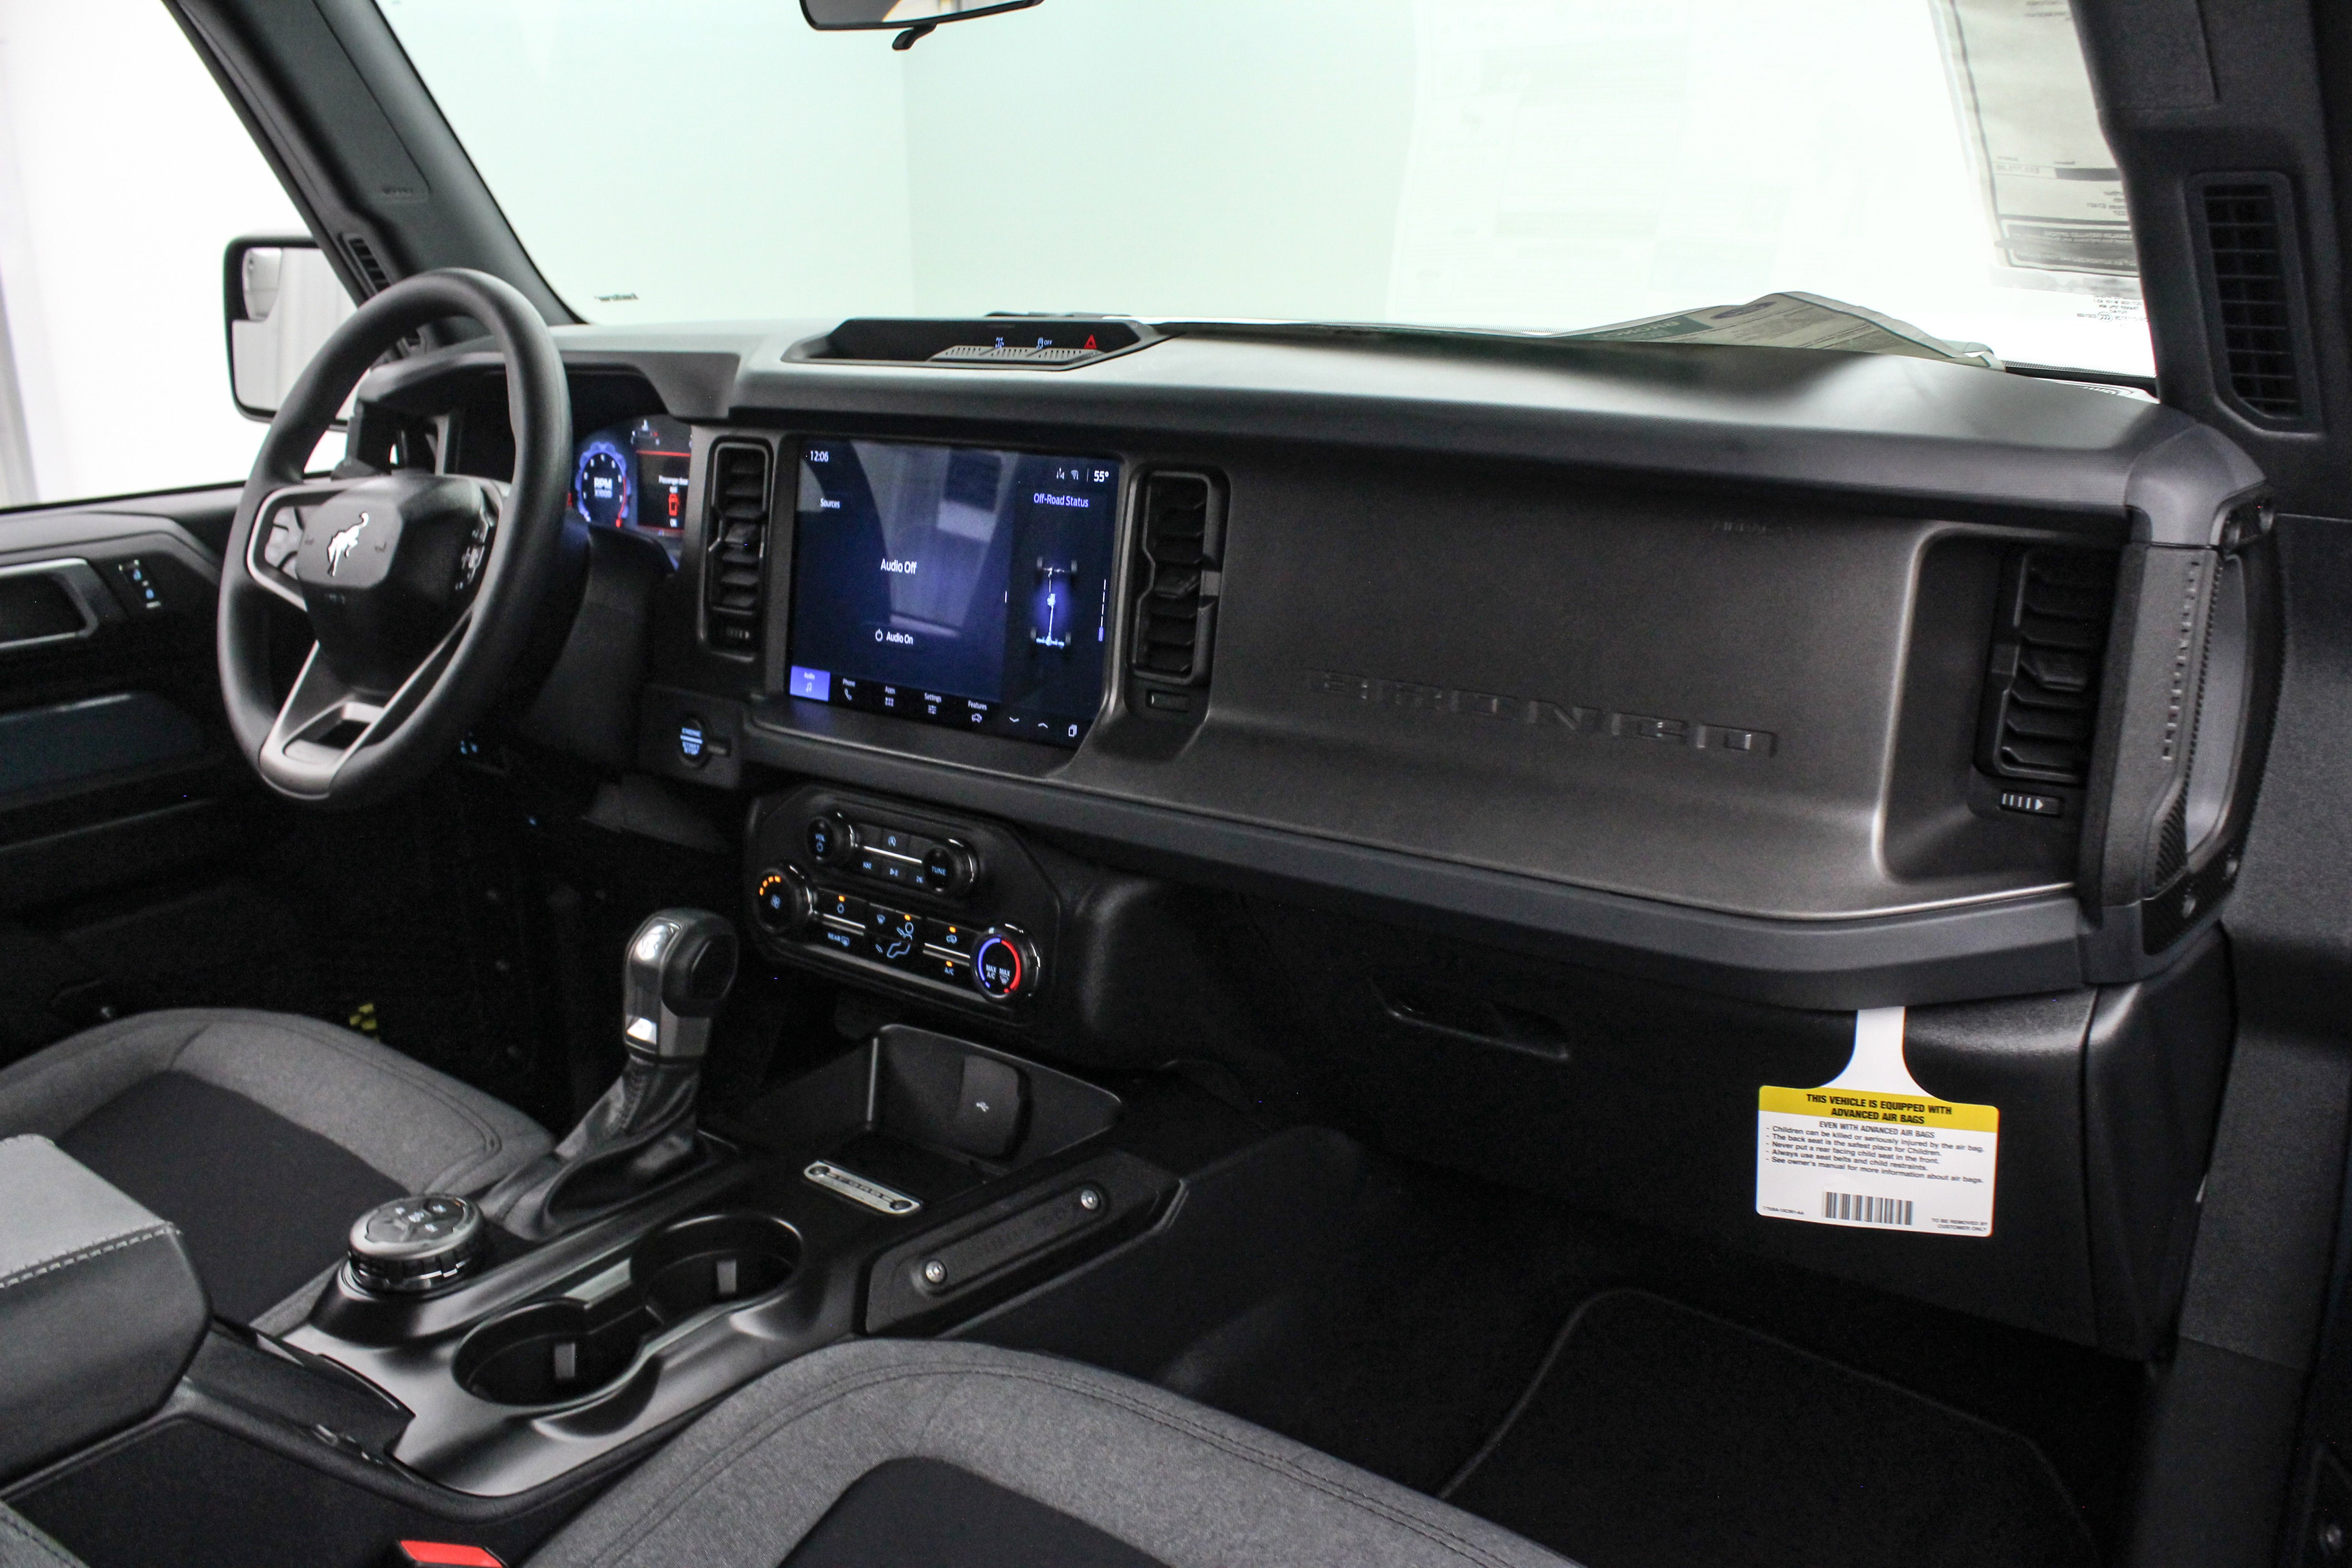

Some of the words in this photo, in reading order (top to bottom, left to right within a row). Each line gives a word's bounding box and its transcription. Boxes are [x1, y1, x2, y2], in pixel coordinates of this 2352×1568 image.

[810, 451, 829, 462] 12:06
[594, 477, 612, 489] RPM
[1093, 470, 1110, 483] 55°
[820, 497, 841, 509] Sources
[1034, 493, 1065, 506] Off-Road
[1065, 495, 1089, 508] Status
[880, 558, 903, 573] Audio
[904, 561, 917, 574] Off
[886, 631, 904, 643] Audio
[904, 634, 914, 645] On
[924, 692, 942, 704] Settings
[968, 700, 988, 711] Features
[1305, 668, 1780, 758] BRONCO
[931, 866, 946, 876] TUNE
[944, 967, 955, 975] A/C
[985, 964, 997, 973] MAX
[999, 968, 1011, 977] MAX
[986, 971, 996, 980] A/C
[1806, 1094, 1827, 1103] THIS
[1829, 1096, 1867, 1107] VEHICLE
[1868, 1099, 1878, 1108] IS
[1880, 1101, 1925, 1112] EQUIPPED
[1927, 1105, 1952, 1115] WITH
[1831, 1107, 1879, 1120] ADVANCED
[1882, 1112, 1897, 1122] AIR
[1900, 1114, 1925, 1124] BAGS
[1819, 1121, 1838, 1129] EVEN
[1839, 1123, 1859, 1131] WITH
[1861, 1125, 1899, 1135] ADVANCED
[1915, 1130, 1935, 1139] BAGS
[1772, 1125, 1804, 1134] Children
[1864, 1136, 1899, 1145] seriously
[1901, 1139, 1928, 1147] injured
[1968, 1145, 1985, 1153] bag.
[1772, 1141, 1793, 1149] Never
[1833, 1147, 1856, 1156] facing
[1872, 1144, 1893, 1152] place
[1907, 1147, 1942, 1156] Children.
[1772, 1149, 1798, 1158] Always
[1890, 1162, 1928, 1171] restraints.
[1787, 1159, 1817, 1167] owner's
[1881, 1169, 1925, 1178] information
